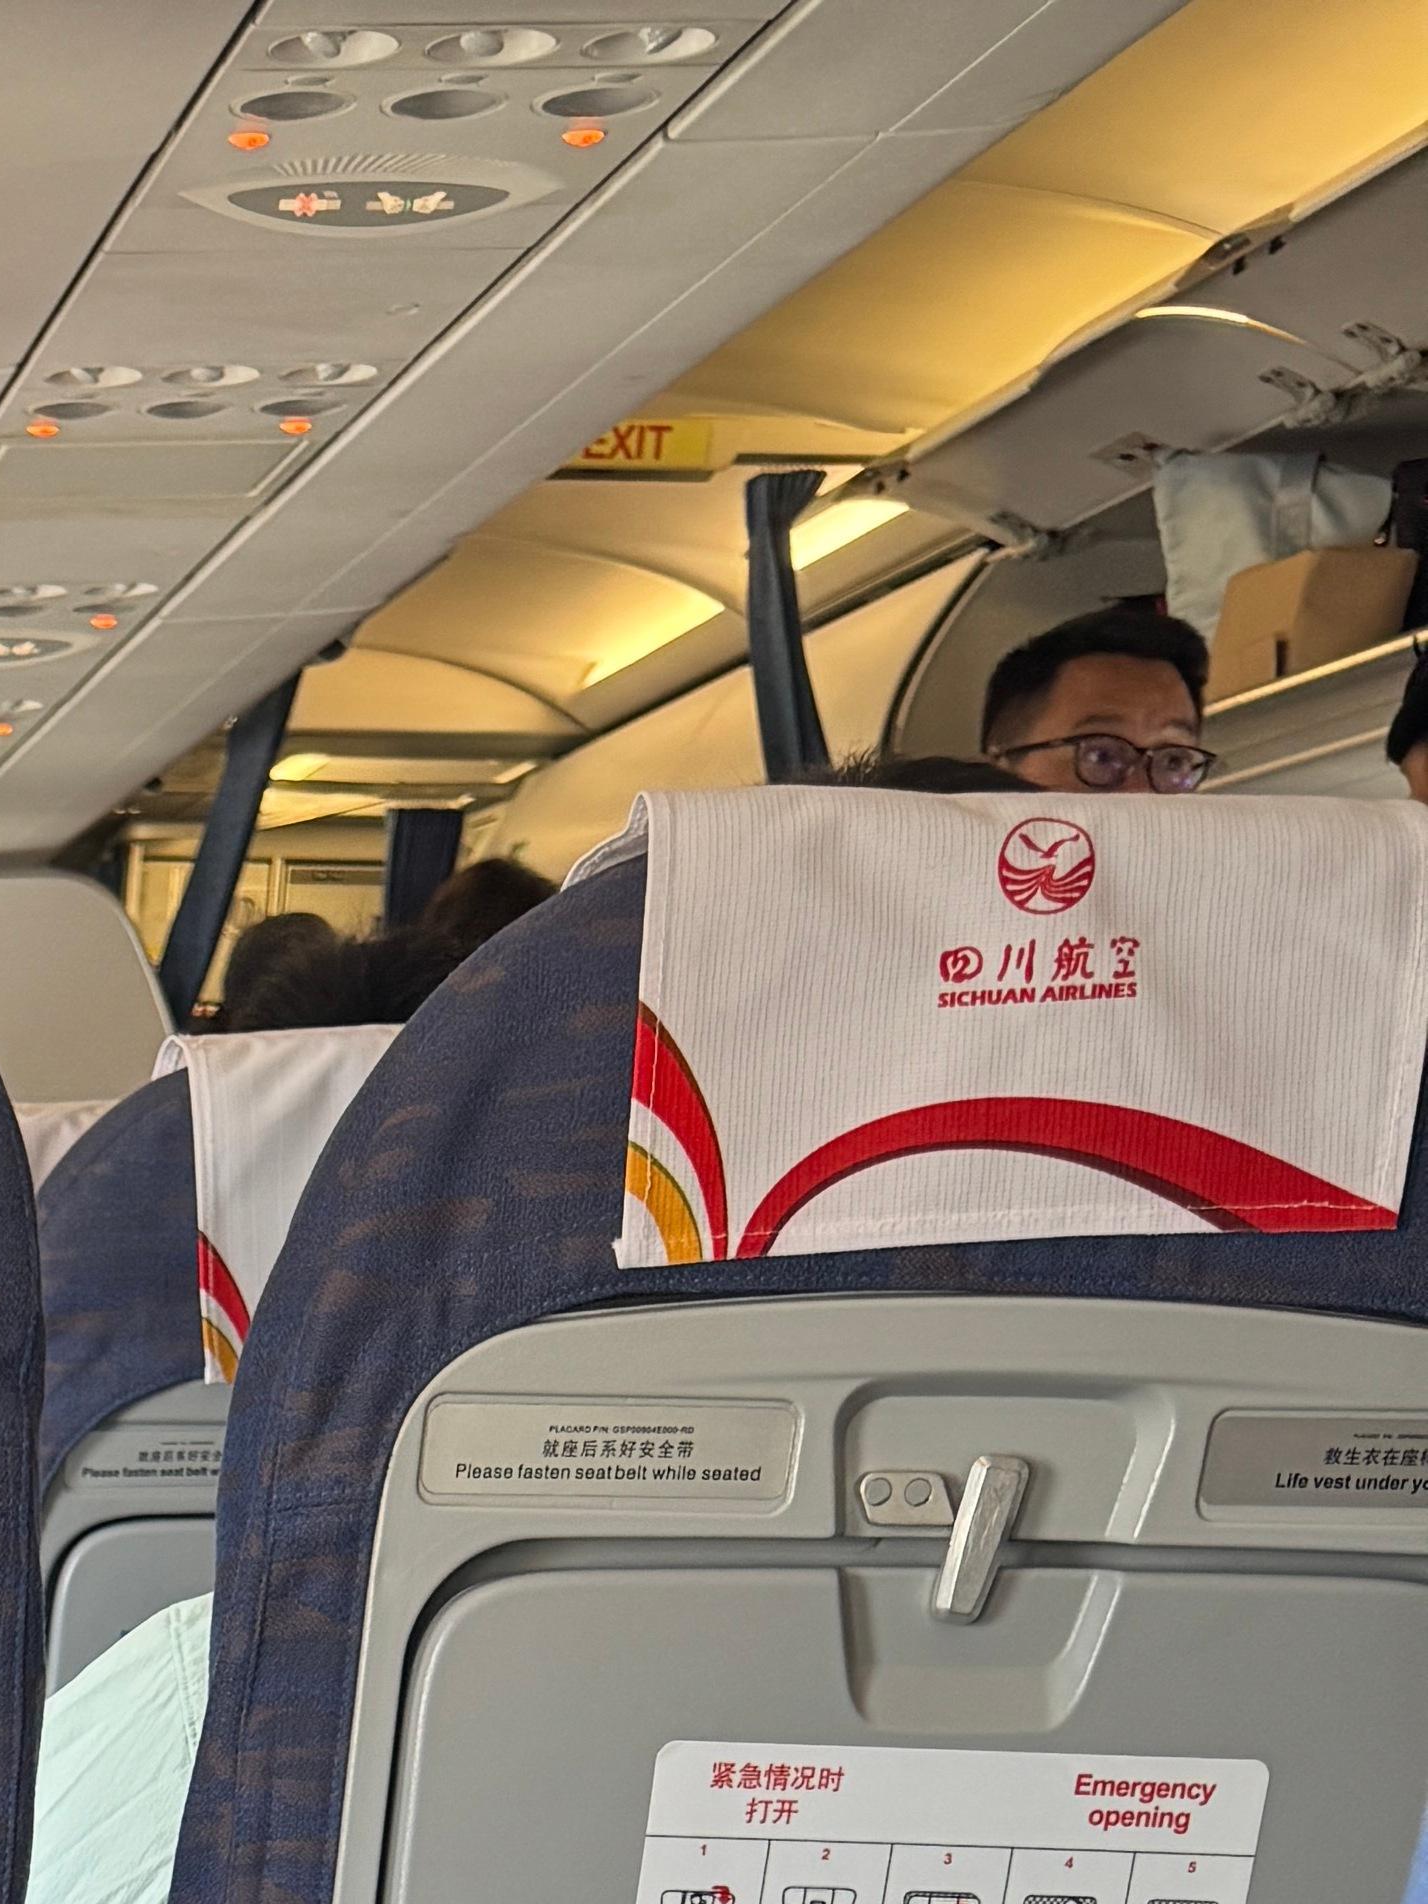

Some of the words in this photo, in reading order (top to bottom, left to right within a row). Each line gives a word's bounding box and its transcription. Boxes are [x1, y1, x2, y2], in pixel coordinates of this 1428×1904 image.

[939, 936, 1140, 984] 四川航空
[937, 987, 1036, 1008] SICHUAN
[1039, 981, 1138, 1004] AIRLINES
[542, 1439, 695, 1459] 就座后系好安全带
[455, 1463, 513, 1480] Please
[518, 1464, 571, 1481] fasten
[575, 1465, 611, 1481] seat
[615, 1465, 647, 1481] belt
[652, 1465, 695, 1481] while
[701, 1466, 762, 1482] seated
[1275, 1473, 1309, 1489] Life
[1314, 1474, 1351, 1490] vest
[1355, 1474, 1409, 1491] under
[710, 1761, 845, 1792] 紧急情况时
[1074, 1773, 1217, 1805] Emergency
[745, 1797, 800, 1825] 打开
[1088, 1805, 1191, 1835] opening
[700, 1844, 707, 1857] 1
[821, 1849, 830, 1861] 2
[943, 1853, 952, 1865] 3
[1064, 1857, 1073, 1868] 4
[1188, 1862, 1196, 1873] 5
